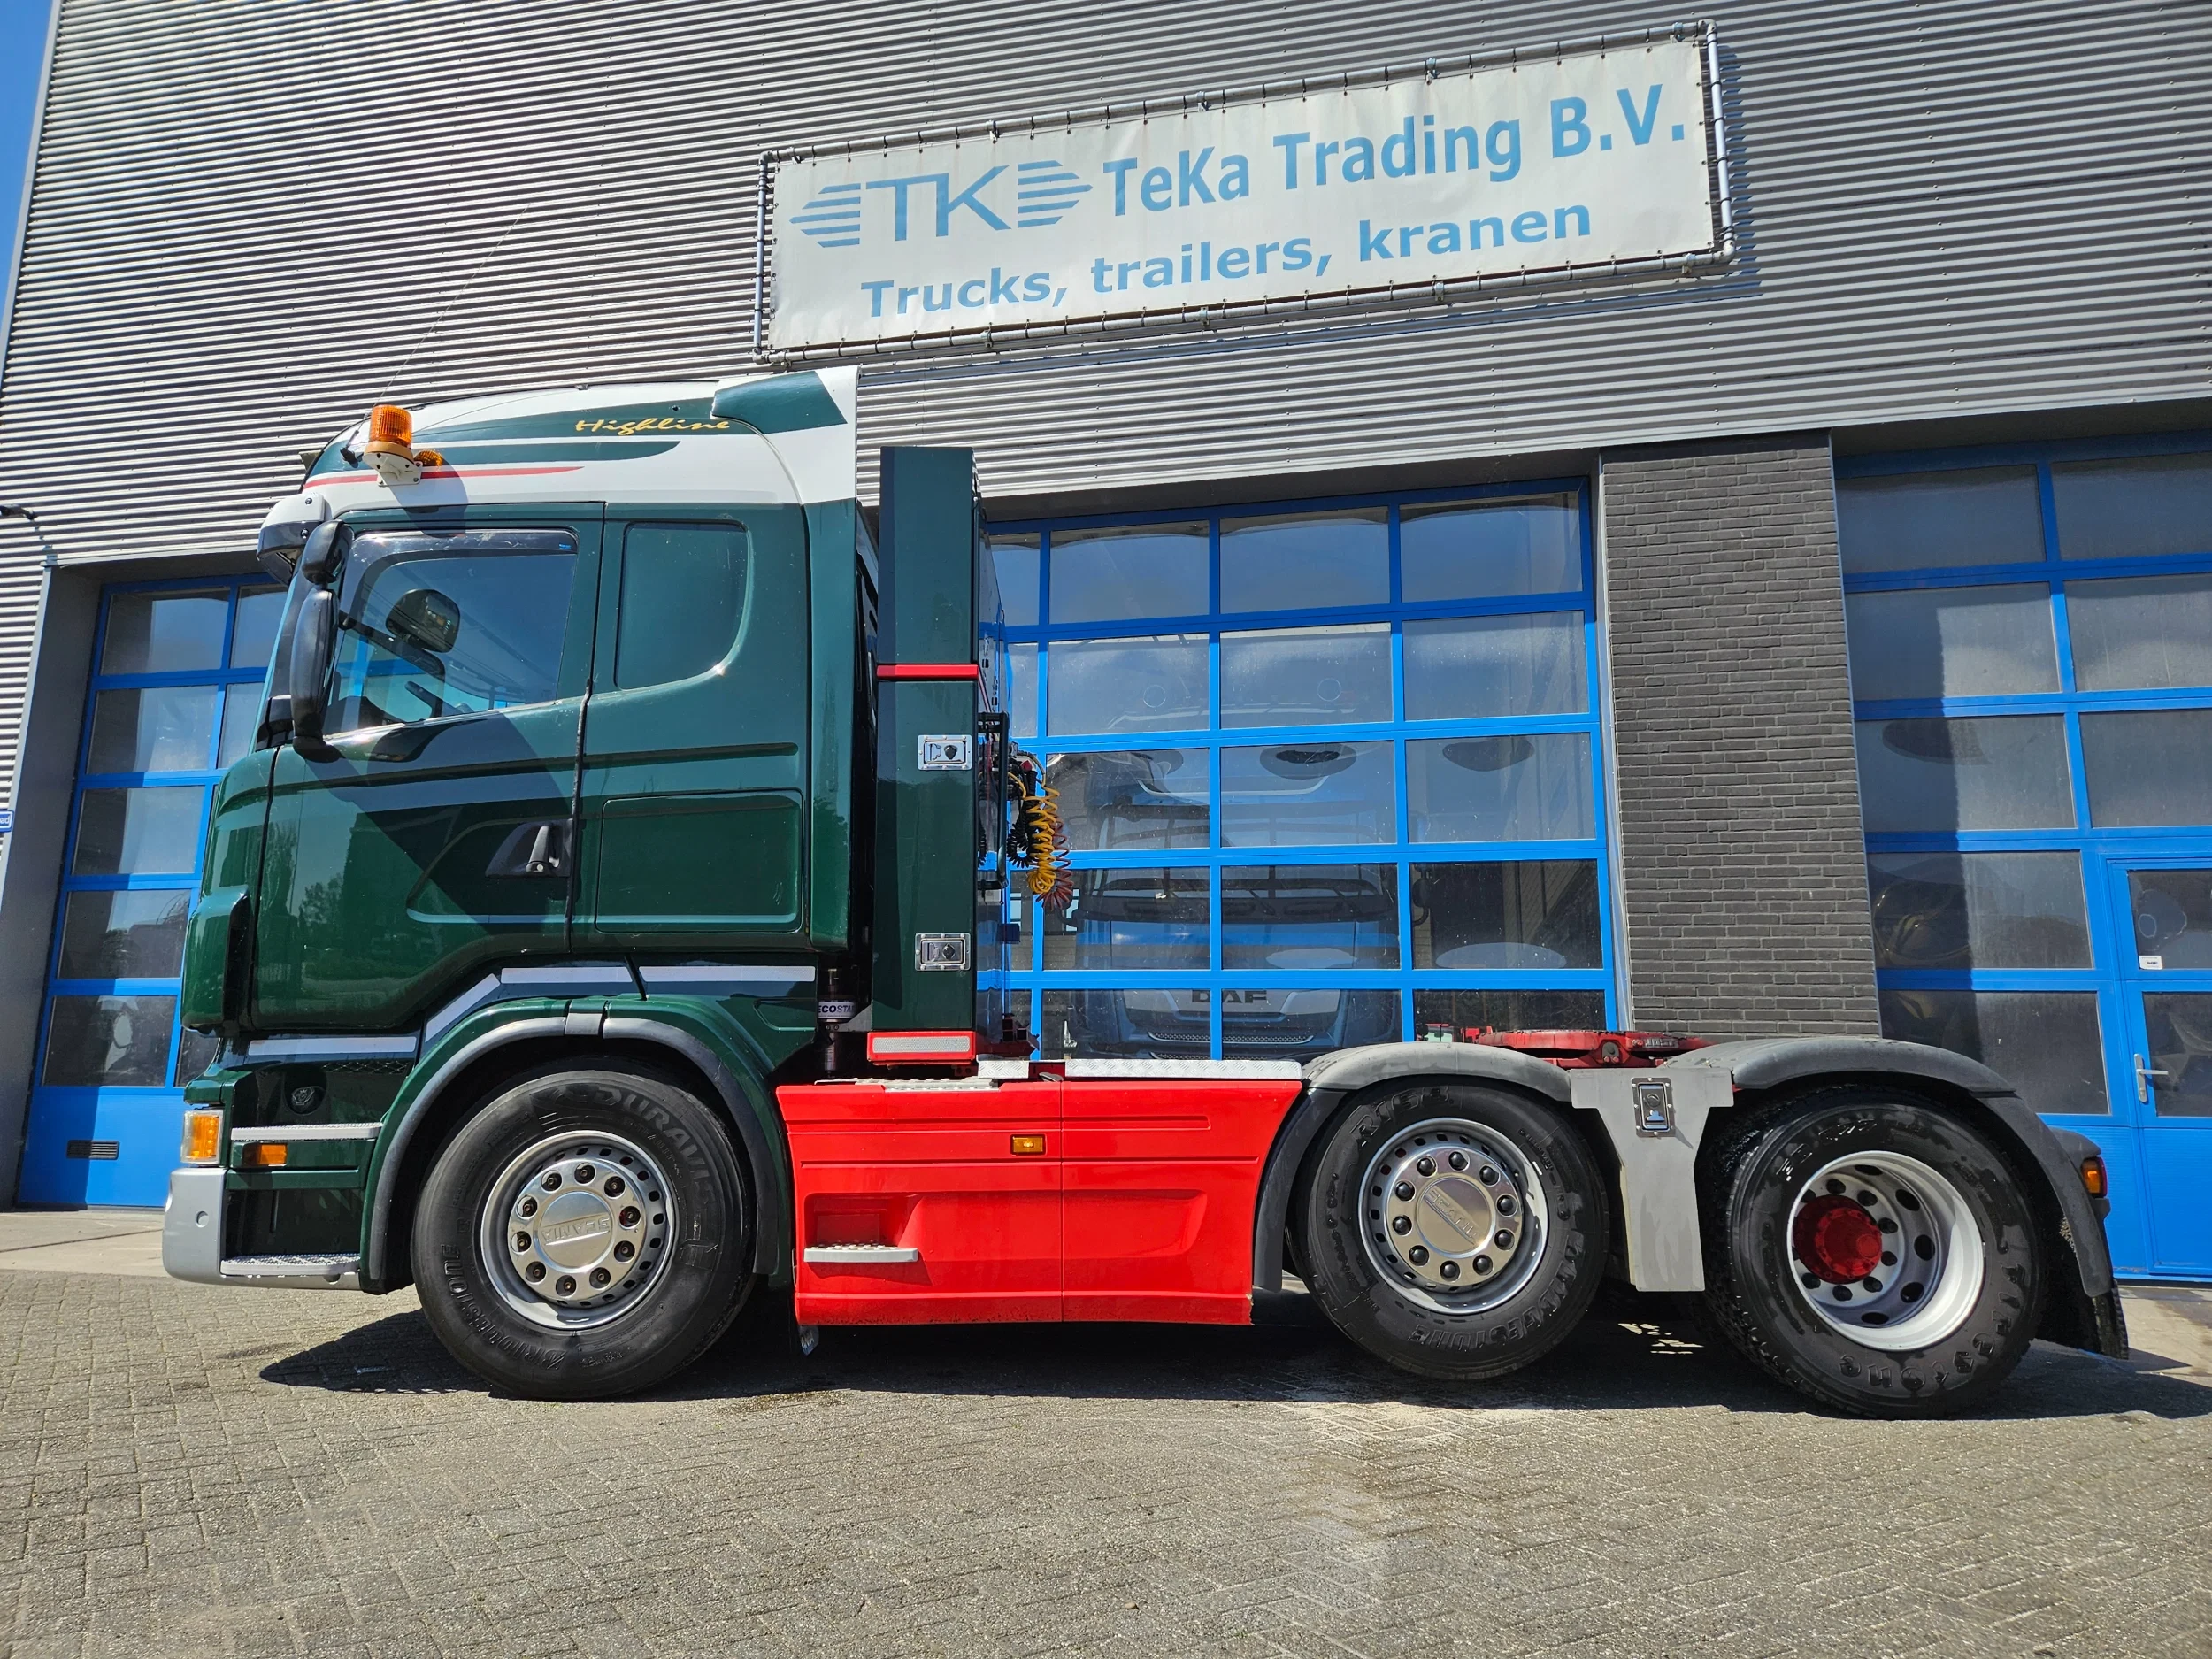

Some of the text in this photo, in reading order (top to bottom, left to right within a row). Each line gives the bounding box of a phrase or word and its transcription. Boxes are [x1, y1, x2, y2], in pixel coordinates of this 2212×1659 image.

[1102, 83, 1686, 217] TeKa Trading B.V.
[862, 204, 1591, 319] Trucks, trailers, kranen
[575, 418, 730, 435] Highline
[1192, 989, 1267, 1003] DAF
[594, 1085, 715, 1204] DURAVIS
[541, 1217, 611, 1242] SCANIA
[442, 1243, 566, 1370] BRIDGESTONE
[1407, 1230, 1586, 1352] BRIDGESTONE
[1839, 1263, 2026, 1391] Firestone
